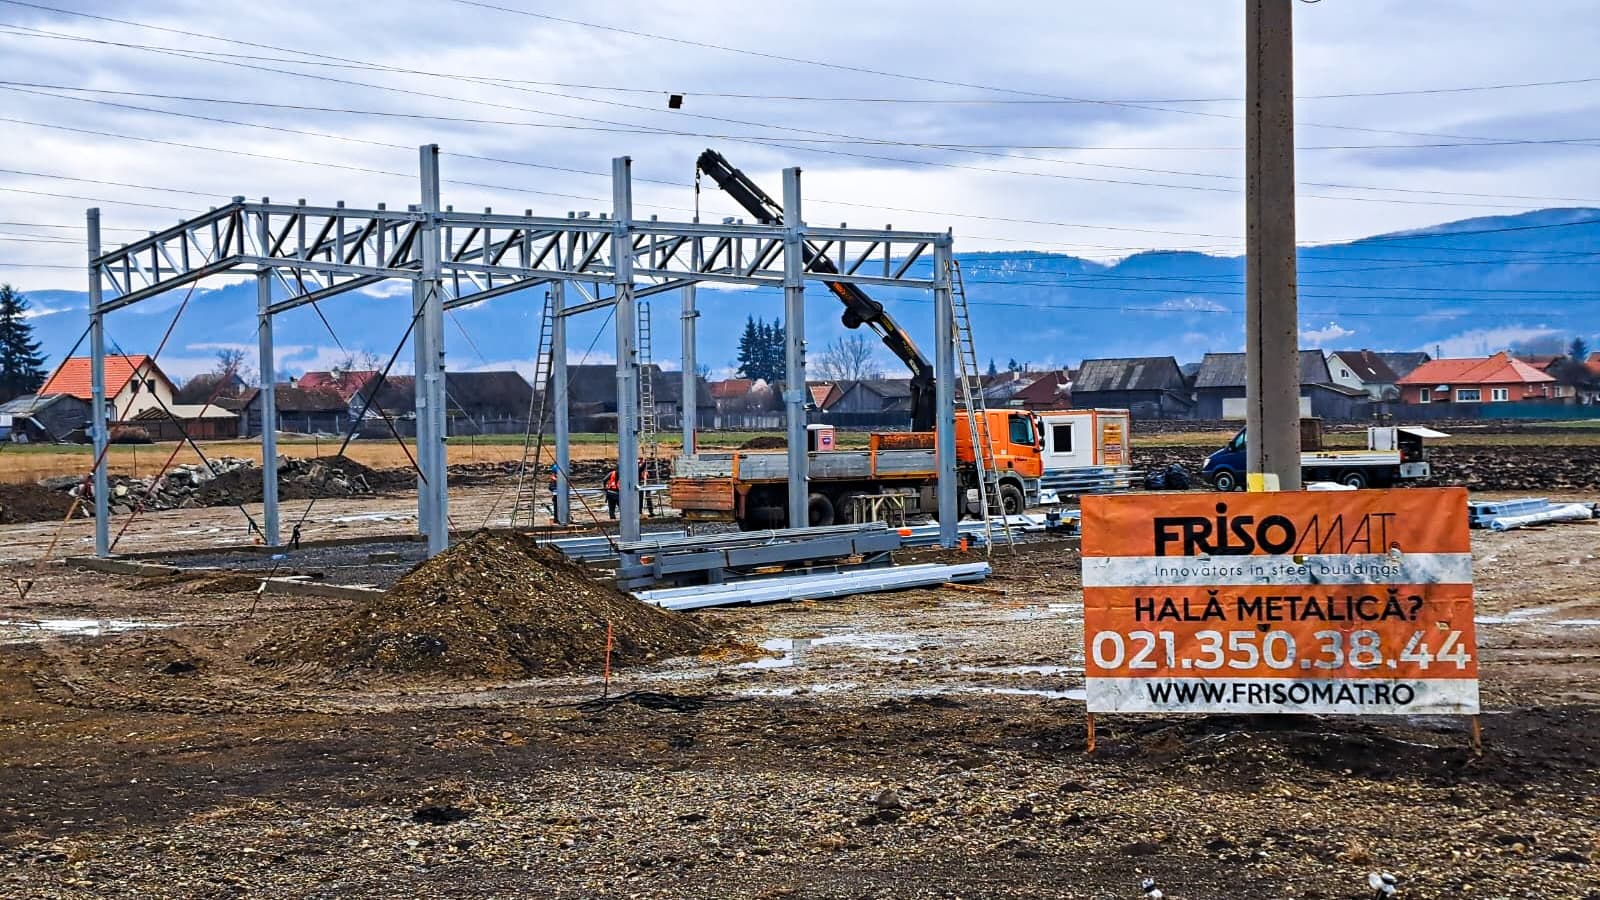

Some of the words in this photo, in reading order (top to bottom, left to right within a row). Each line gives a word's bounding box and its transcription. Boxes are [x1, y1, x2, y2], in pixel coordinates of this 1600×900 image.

[1154, 565, 1242, 578] Innovators
[1250, 565, 1264, 576] in
[1271, 564, 1313, 576] steel
[1320, 562, 1399, 578] buildings
[1135, 589, 1226, 622] HALĂ
[1237, 588, 1423, 622] METALICĂ?
[1091, 629, 1472, 671] 021.350.38.44
[1146, 682, 1415, 706] WWW.FRISOMAT.RO
